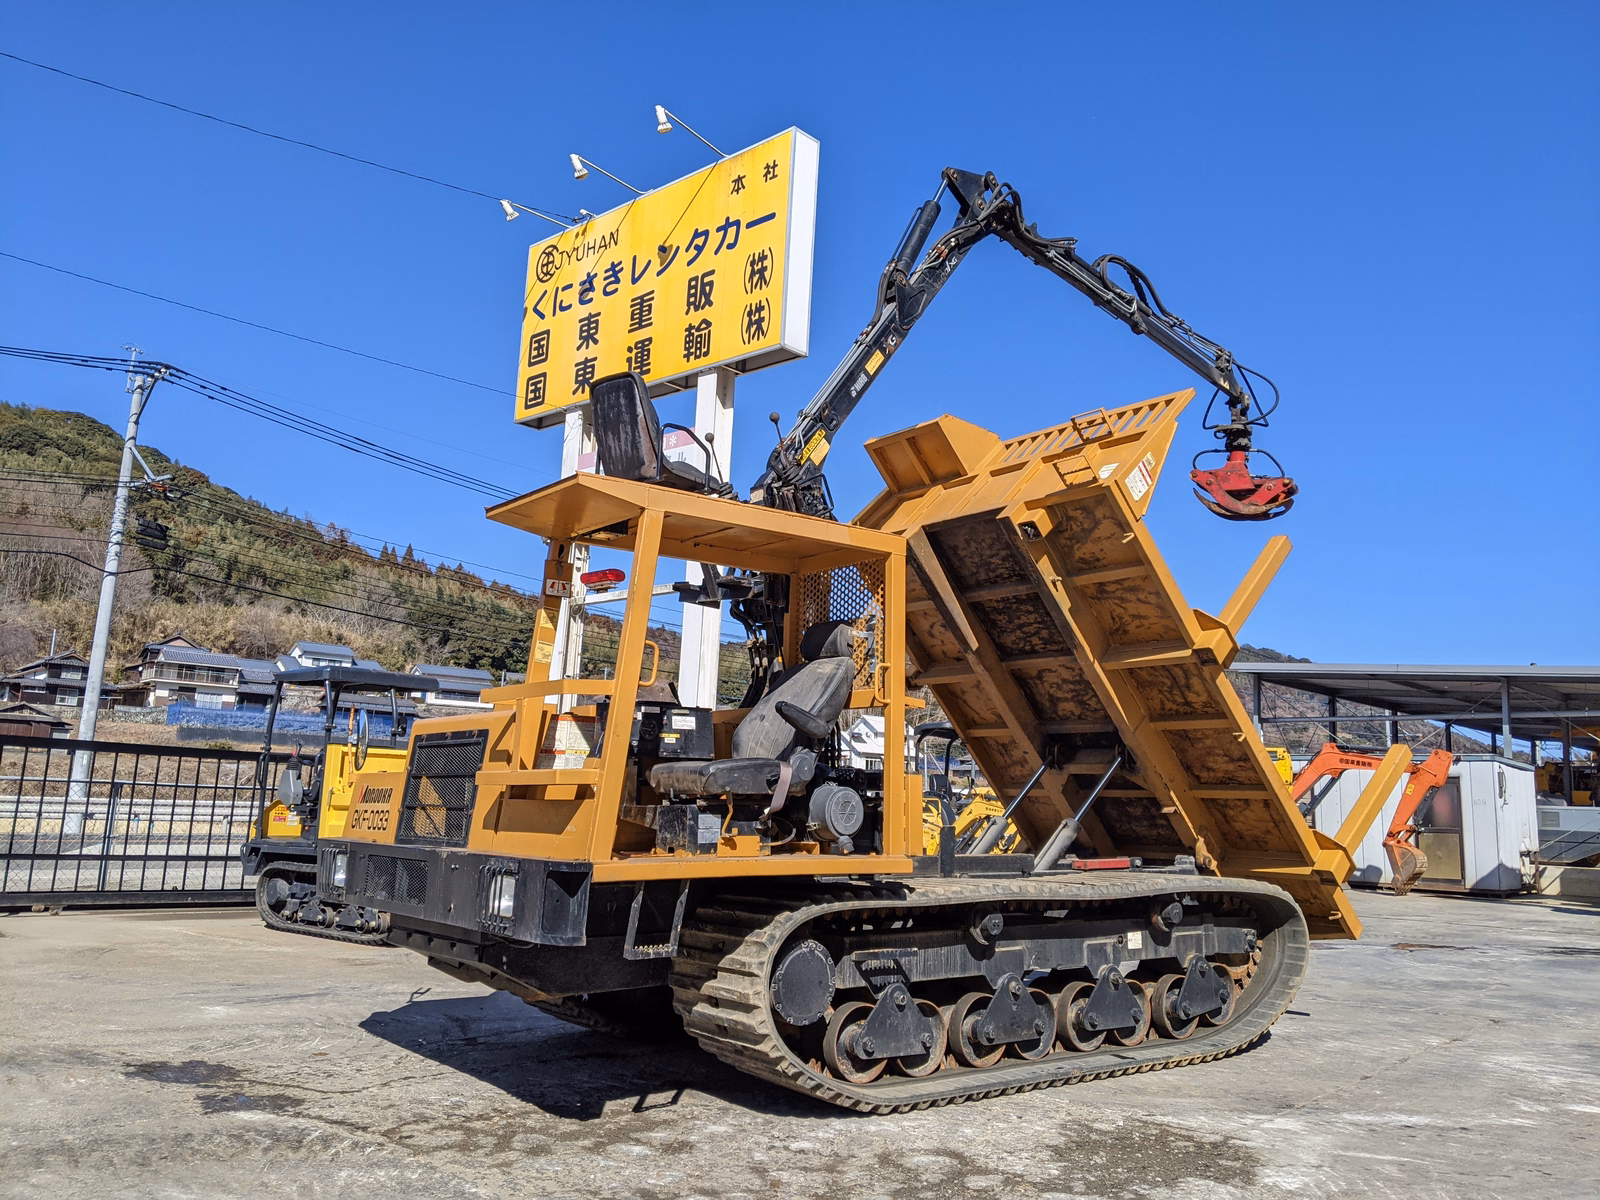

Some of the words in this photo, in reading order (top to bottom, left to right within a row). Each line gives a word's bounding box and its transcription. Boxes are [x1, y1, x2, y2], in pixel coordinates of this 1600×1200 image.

[730, 160, 779, 196] 本社
[532, 212, 777, 320] くにさきレンタカー
[554, 228, 620, 270] JYUHAN
